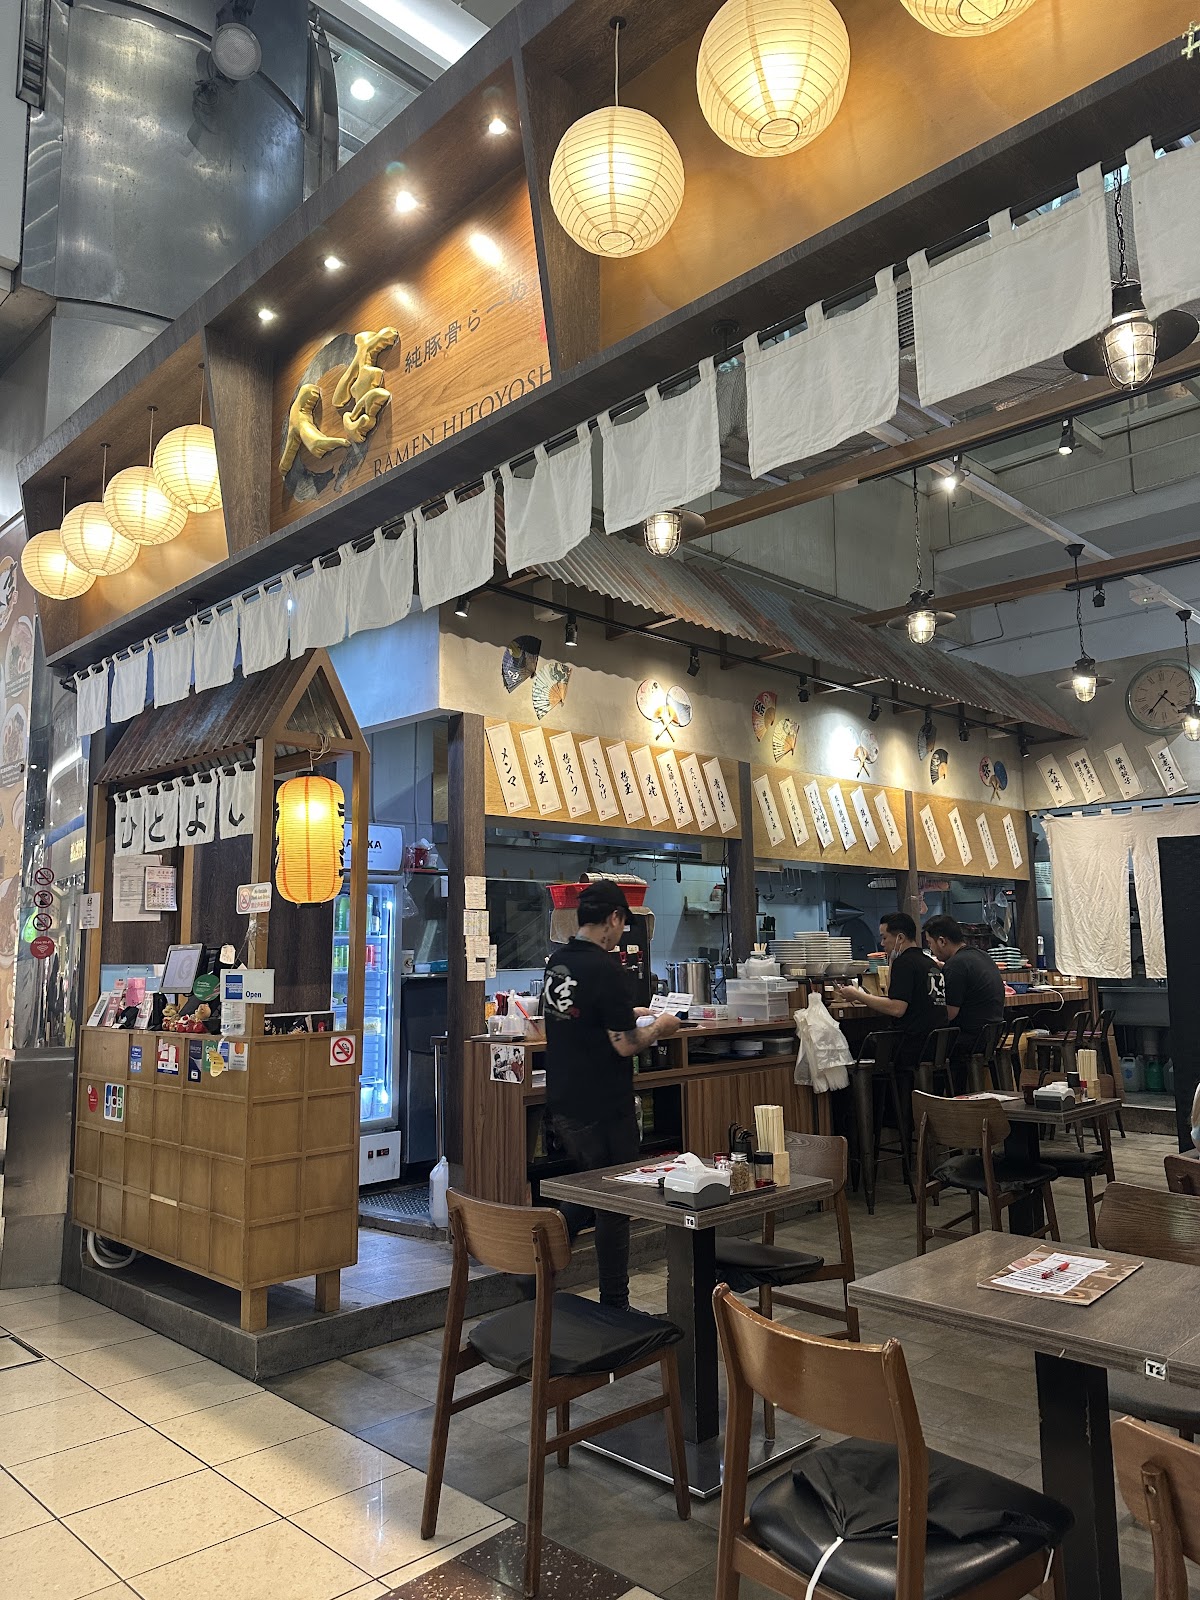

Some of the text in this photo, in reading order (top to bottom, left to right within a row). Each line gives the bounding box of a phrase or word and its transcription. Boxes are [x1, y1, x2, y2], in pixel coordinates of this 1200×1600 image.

[373, 426, 435, 478] RAMEN
[501, 748, 516, 786] メンマ
[533, 754, 548, 784] 味玉
[592, 758, 607, 799] きくらげ
[245, 990, 262, 998] Open
[106, 1095, 122, 1108] JCB
[1147, 1363, 1163, 1377] T2
